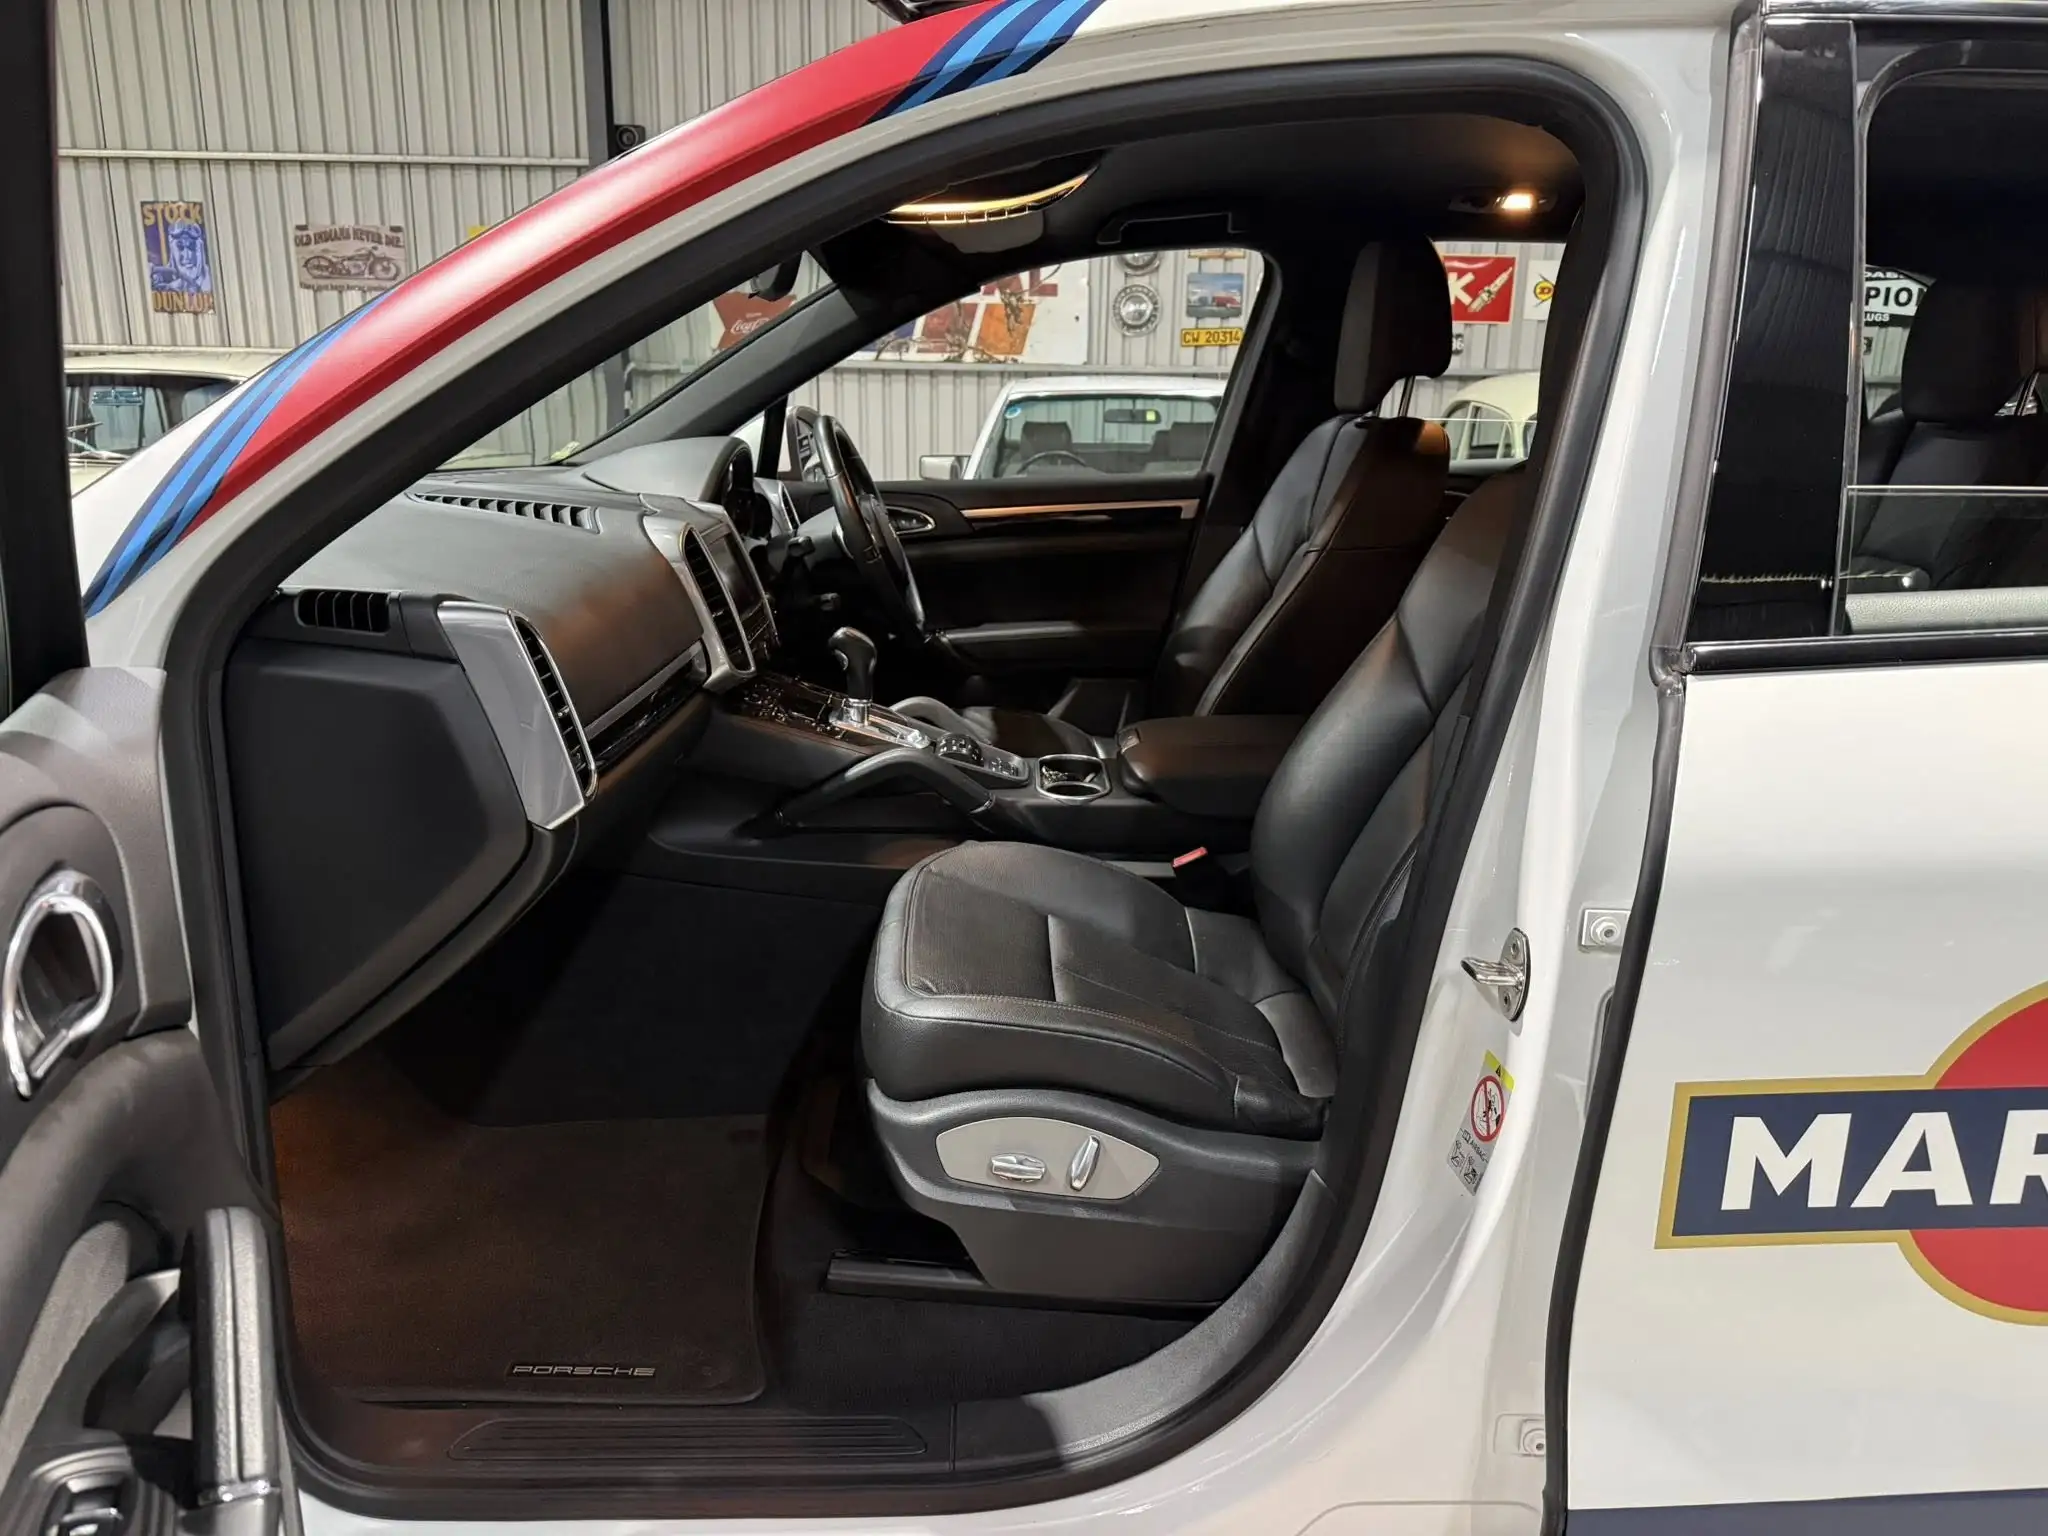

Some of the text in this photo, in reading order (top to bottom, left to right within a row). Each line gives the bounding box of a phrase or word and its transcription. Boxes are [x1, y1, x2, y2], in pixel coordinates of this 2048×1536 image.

[353, 227, 383, 245] NEVER
[1448, 272, 1475, 306] K
[153, 290, 214, 313] DUNLOP
[1864, 313, 1890, 322] UGS
[1183, 329, 1241, 344] CW 20314
[513, 1365, 656, 1376] PORSCHE
